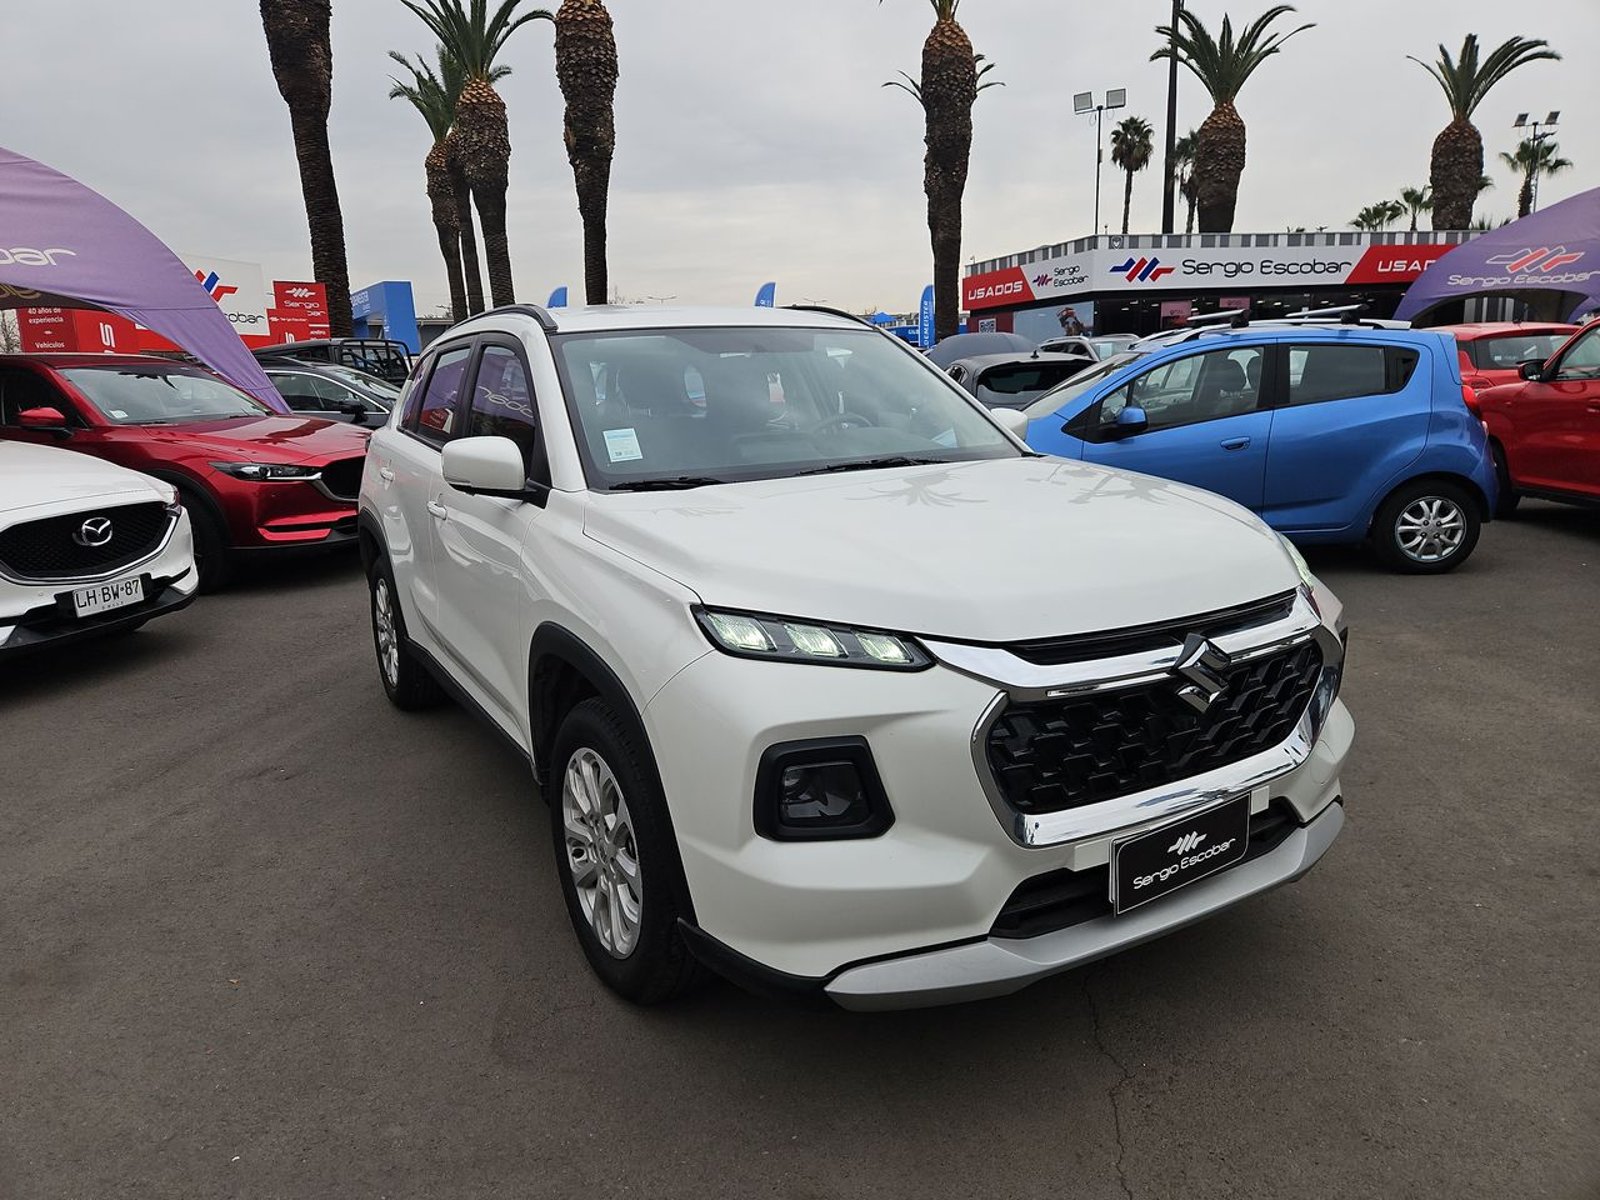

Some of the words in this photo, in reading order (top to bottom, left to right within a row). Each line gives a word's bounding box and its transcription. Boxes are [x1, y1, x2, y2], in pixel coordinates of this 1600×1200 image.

[1054, 265, 1080, 277] Sergio
[1182, 259, 1254, 278] Sergio
[1260, 260, 1352, 275] Escobar
[1054, 275, 1089, 287] Escobar
[1447, 275, 1511, 287] Sergio
[1514, 271, 1600, 285] Escobar
[968, 281, 1023, 300] USADOS
[1133, 863, 1180, 889] Sergio
[1180, 838, 1236, 869] Escobar
